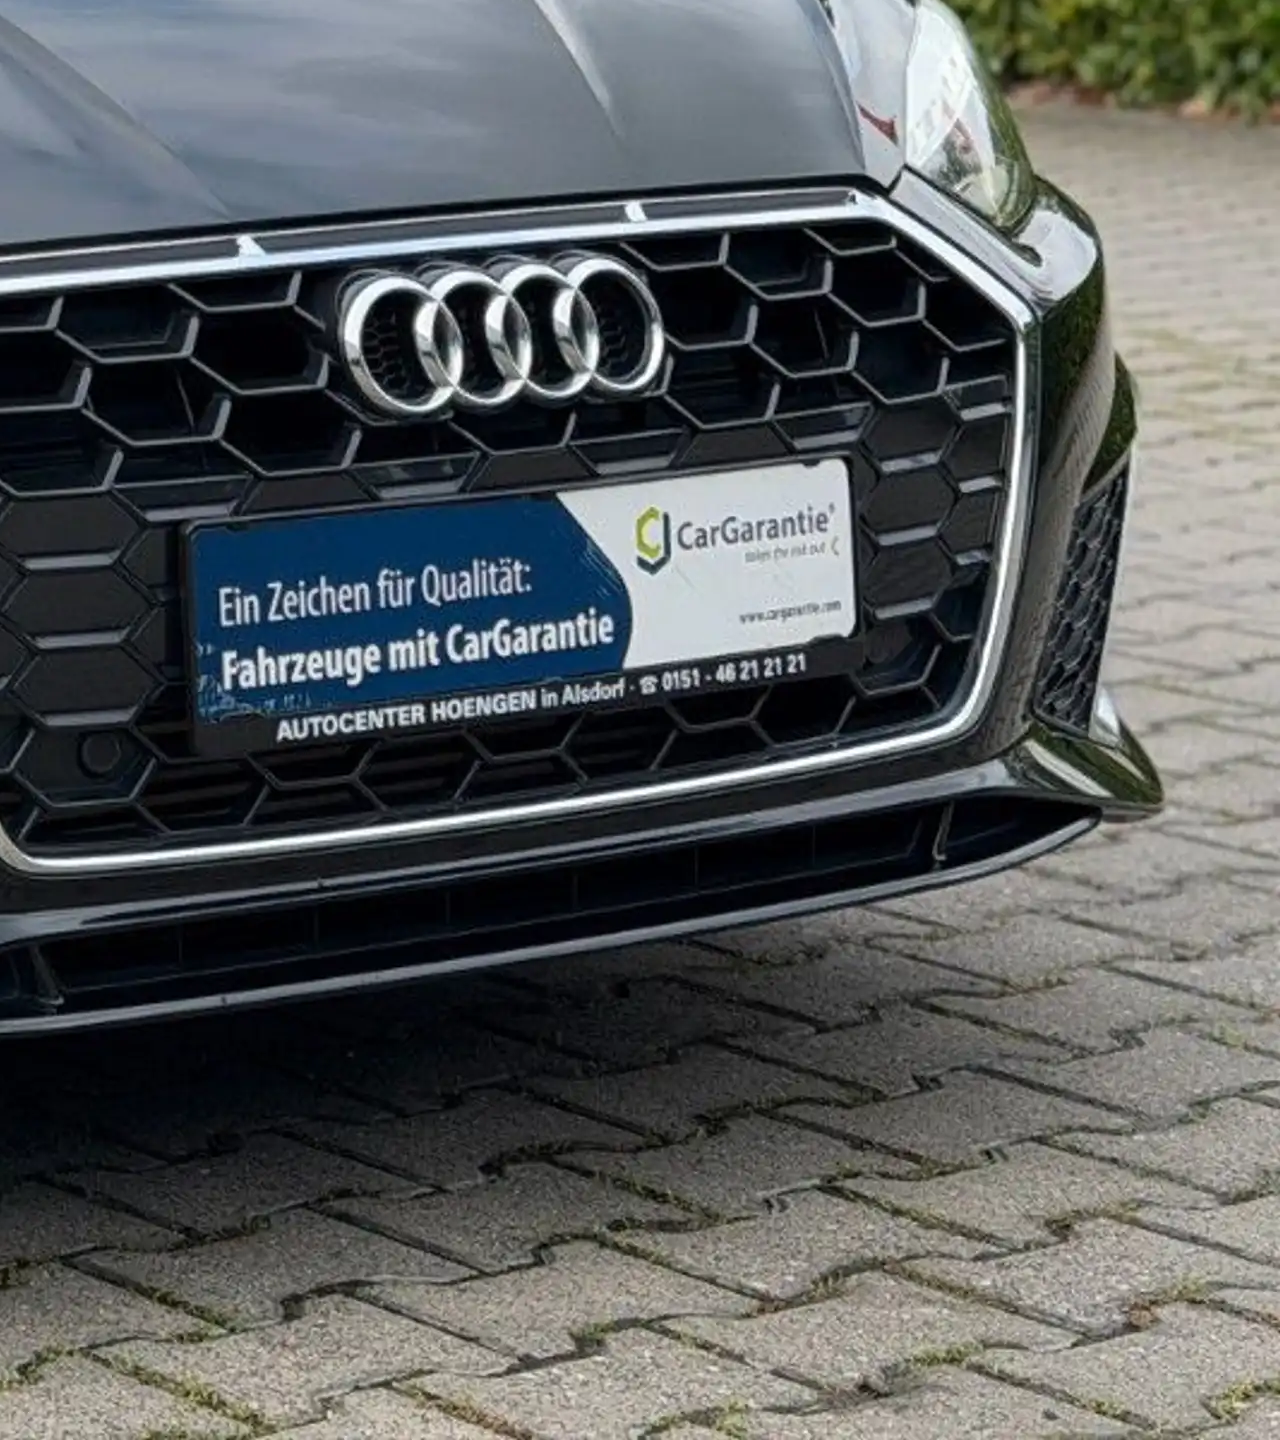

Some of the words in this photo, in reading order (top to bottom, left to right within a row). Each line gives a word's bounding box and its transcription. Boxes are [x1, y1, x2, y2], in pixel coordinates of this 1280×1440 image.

[218, 586, 260, 627] Ein
[267, 573, 371, 620] Zeichen
[377, 567, 415, 609] für
[421, 558, 532, 606] Qualität:
[221, 644, 381, 691] Fahrzeuge
[389, 628, 440, 672] mit
[445, 607, 615, 664] CarGarantie
[276, 702, 425, 742] AUTOCENTER
[431, 688, 537, 724] HOENGEN
[540, 685, 560, 708] in
[561, 674, 626, 706] Alsdorf
[662, 668, 702, 694] 0151
[740, 659, 759, 680] 21
[764, 656, 782, 677] 21
[787, 652, 807, 674] 21
